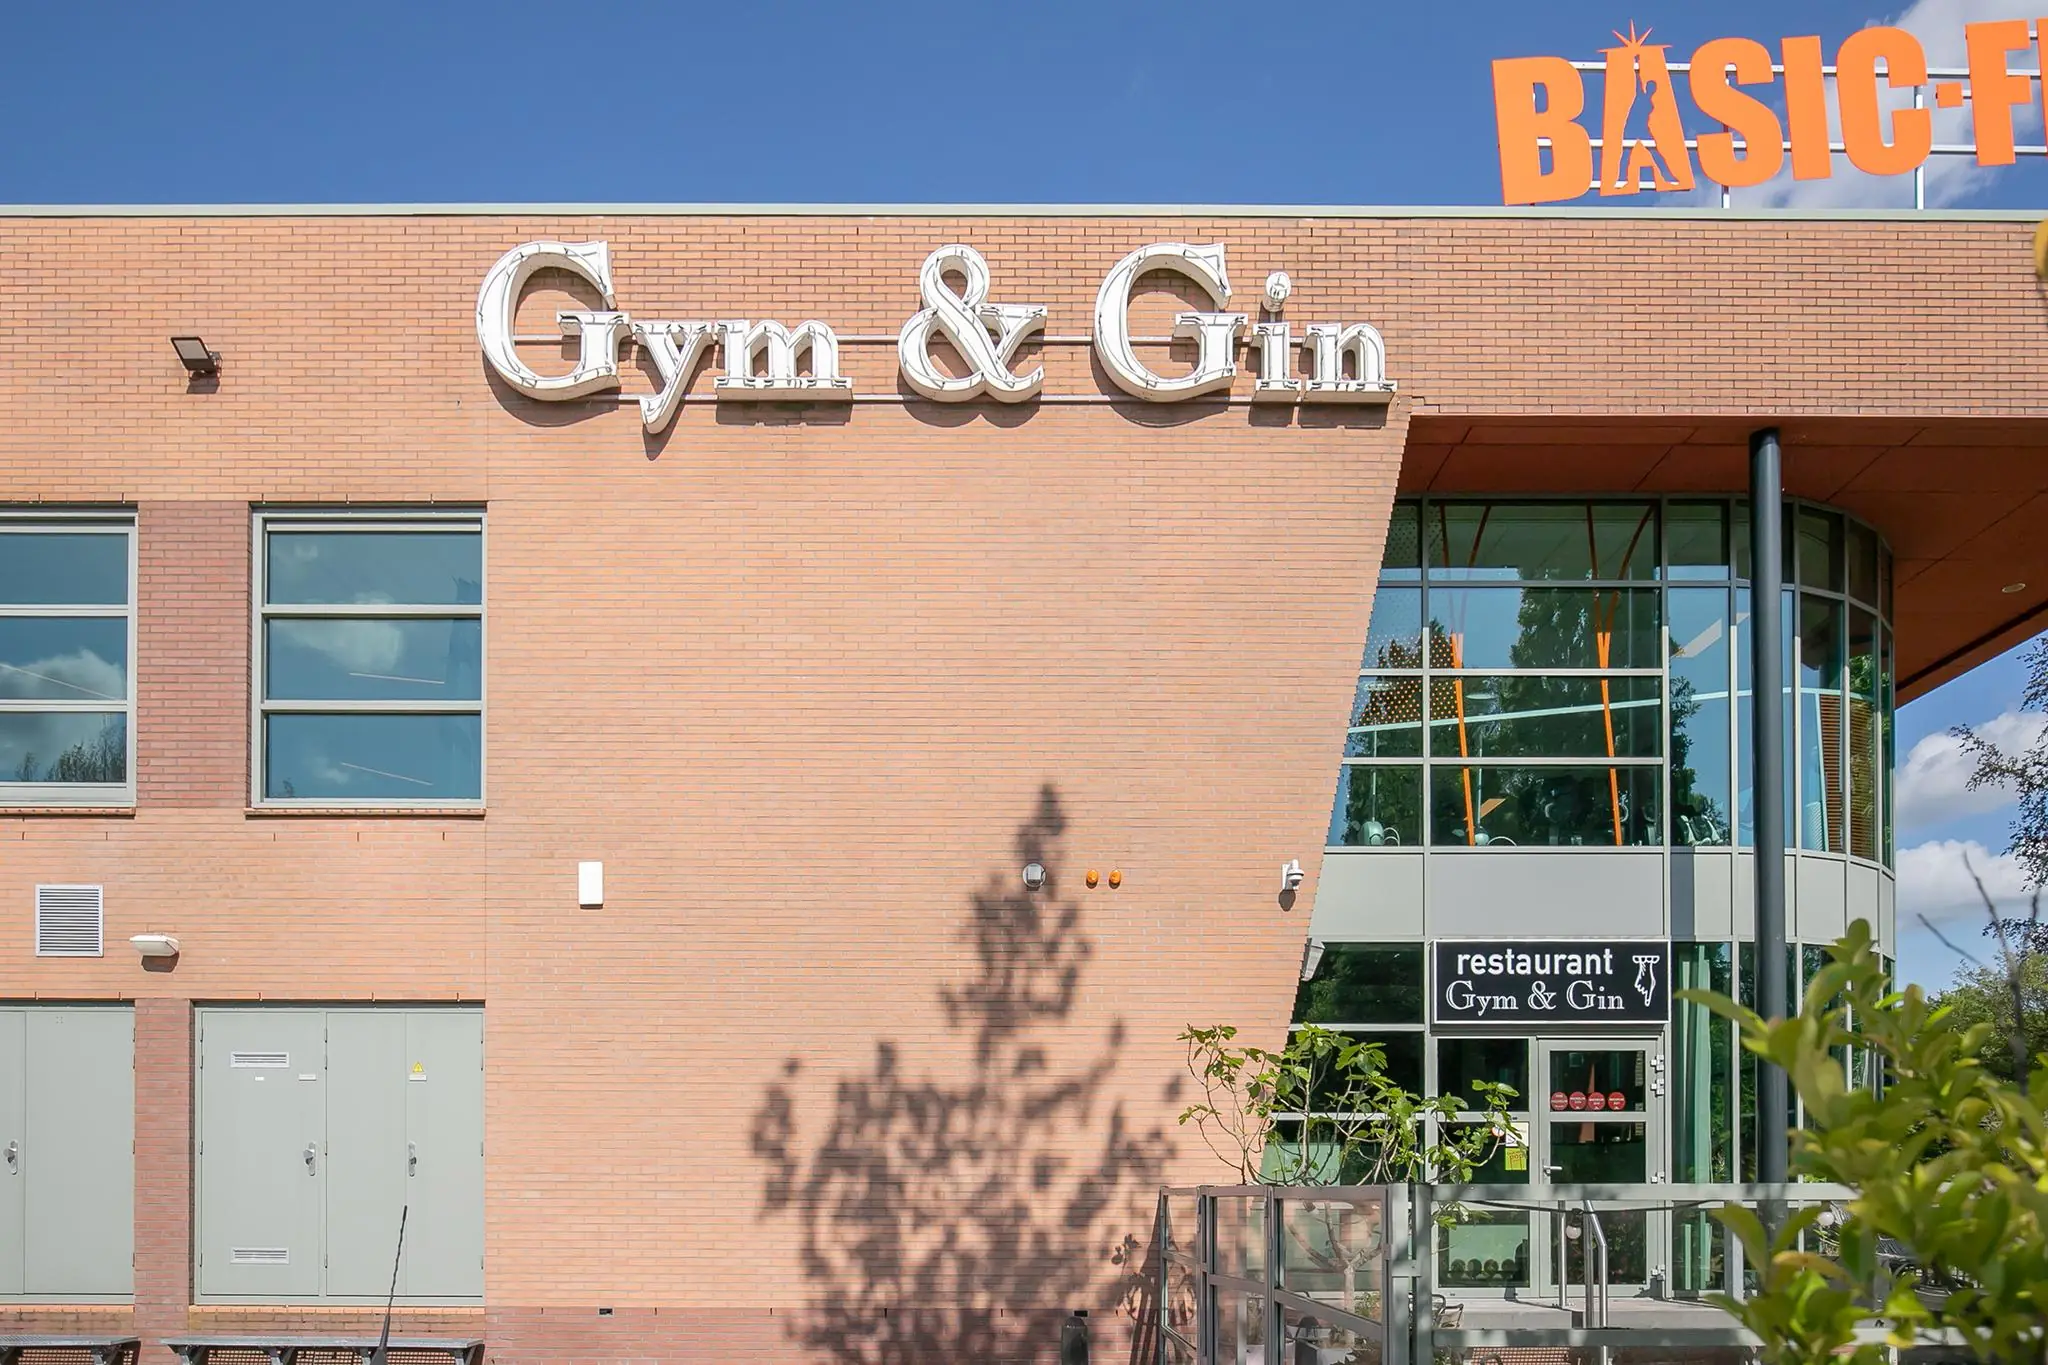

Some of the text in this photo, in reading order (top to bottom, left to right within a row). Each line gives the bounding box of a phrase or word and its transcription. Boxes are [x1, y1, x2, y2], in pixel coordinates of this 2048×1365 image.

[1492, 17, 2048, 206] BASIC-F
[476, 240, 1398, 434] Gym & Gin
[1445, 980, 1625, 1016] Gym & Gin
[1456, 948, 1614, 976] restaurant
